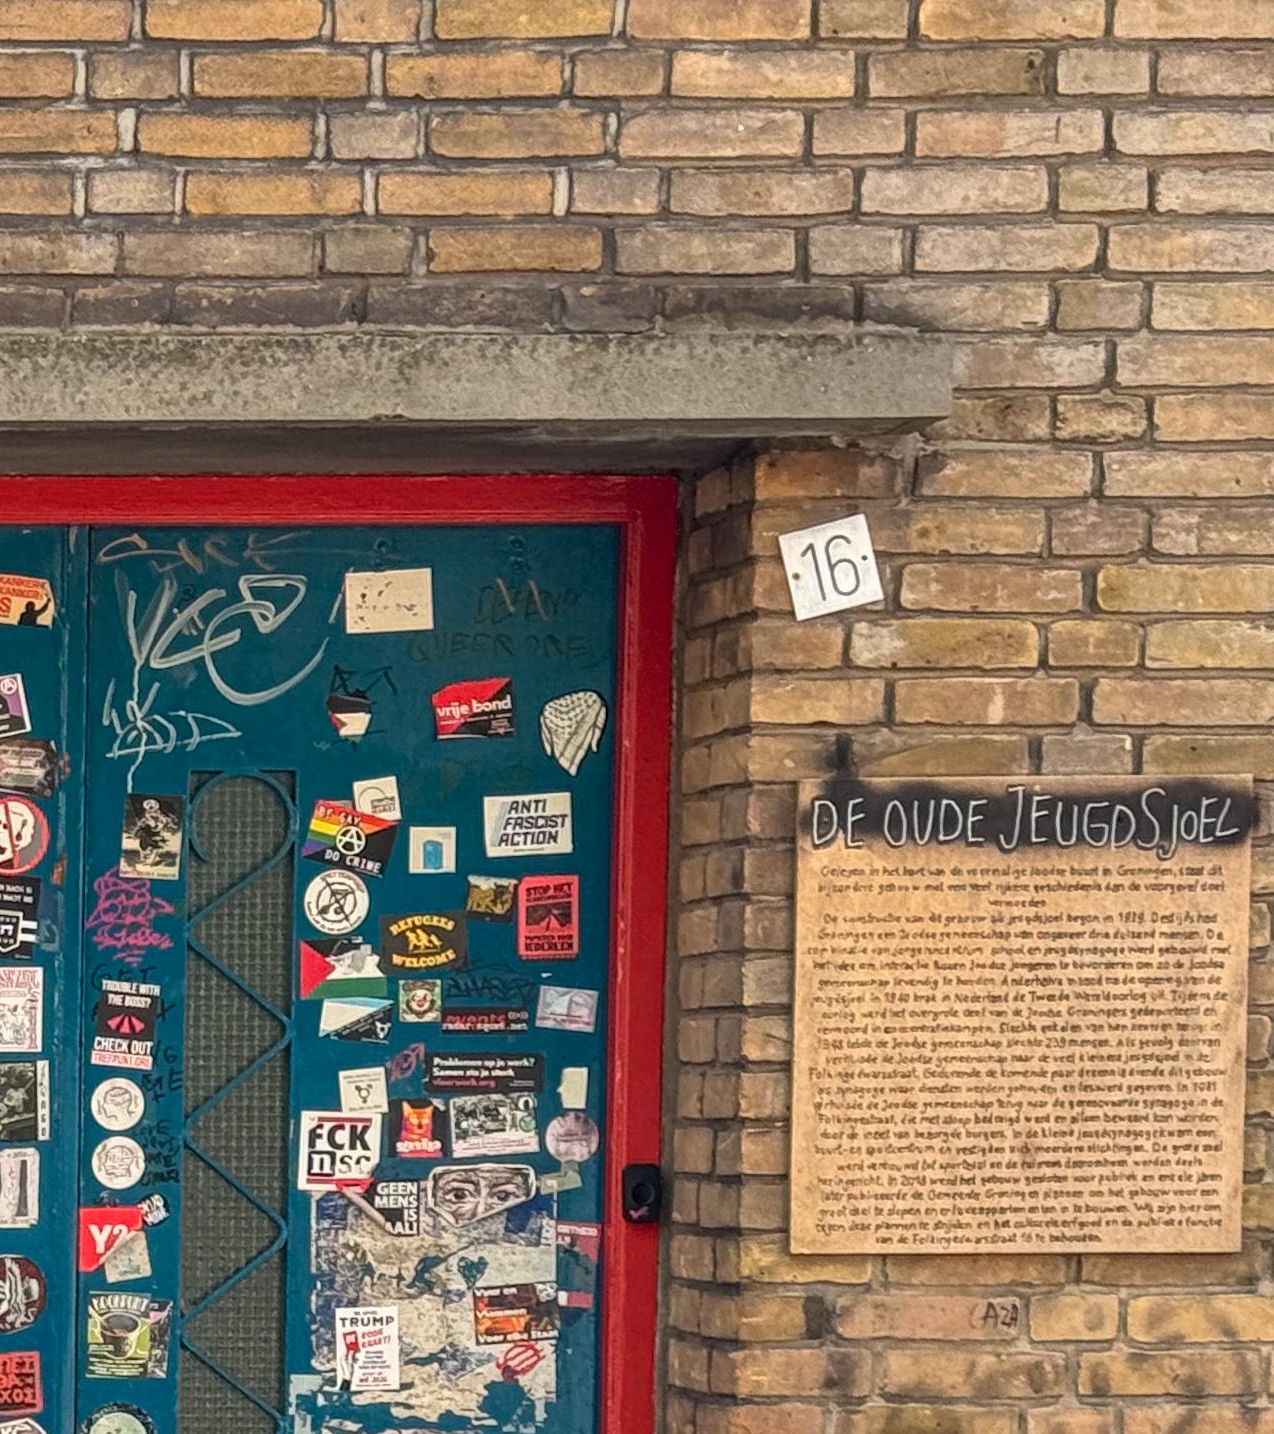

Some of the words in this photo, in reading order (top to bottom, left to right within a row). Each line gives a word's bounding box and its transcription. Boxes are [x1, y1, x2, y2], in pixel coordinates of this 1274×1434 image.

[801, 535, 860, 601] 16
[436, 699, 470, 719] vrije
[472, 694, 513, 713] bond
[318, 804, 336, 820] BE
[339, 810, 362, 826] GAY
[508, 798, 548, 816] ANTI
[503, 814, 568, 831] FASCIST
[812, 797, 865, 847] DE
[884, 799, 988, 846] OUDE
[499, 829, 559, 848] ACTION
[324, 849, 341, 863] DO
[345, 854, 383, 874] CRIME
[389, 914, 455, 936] REFUGEES
[391, 948, 457, 969] WELCOME
[138, 983, 161, 996] WITH
[108, 993, 126, 1006] THE
[94, 1036, 126, 1053] CHECK
[128, 1041, 154, 1056] OUT
[433, 1057, 482, 1067] Problemen
[433, 1068, 464, 1077] Samen
[377, 1182, 418, 1195] GEEN
[374, 1195, 418, 1209] MENS
[403, 1209, 418, 1221] IS
[339, 1316, 394, 1328] TRUMP
